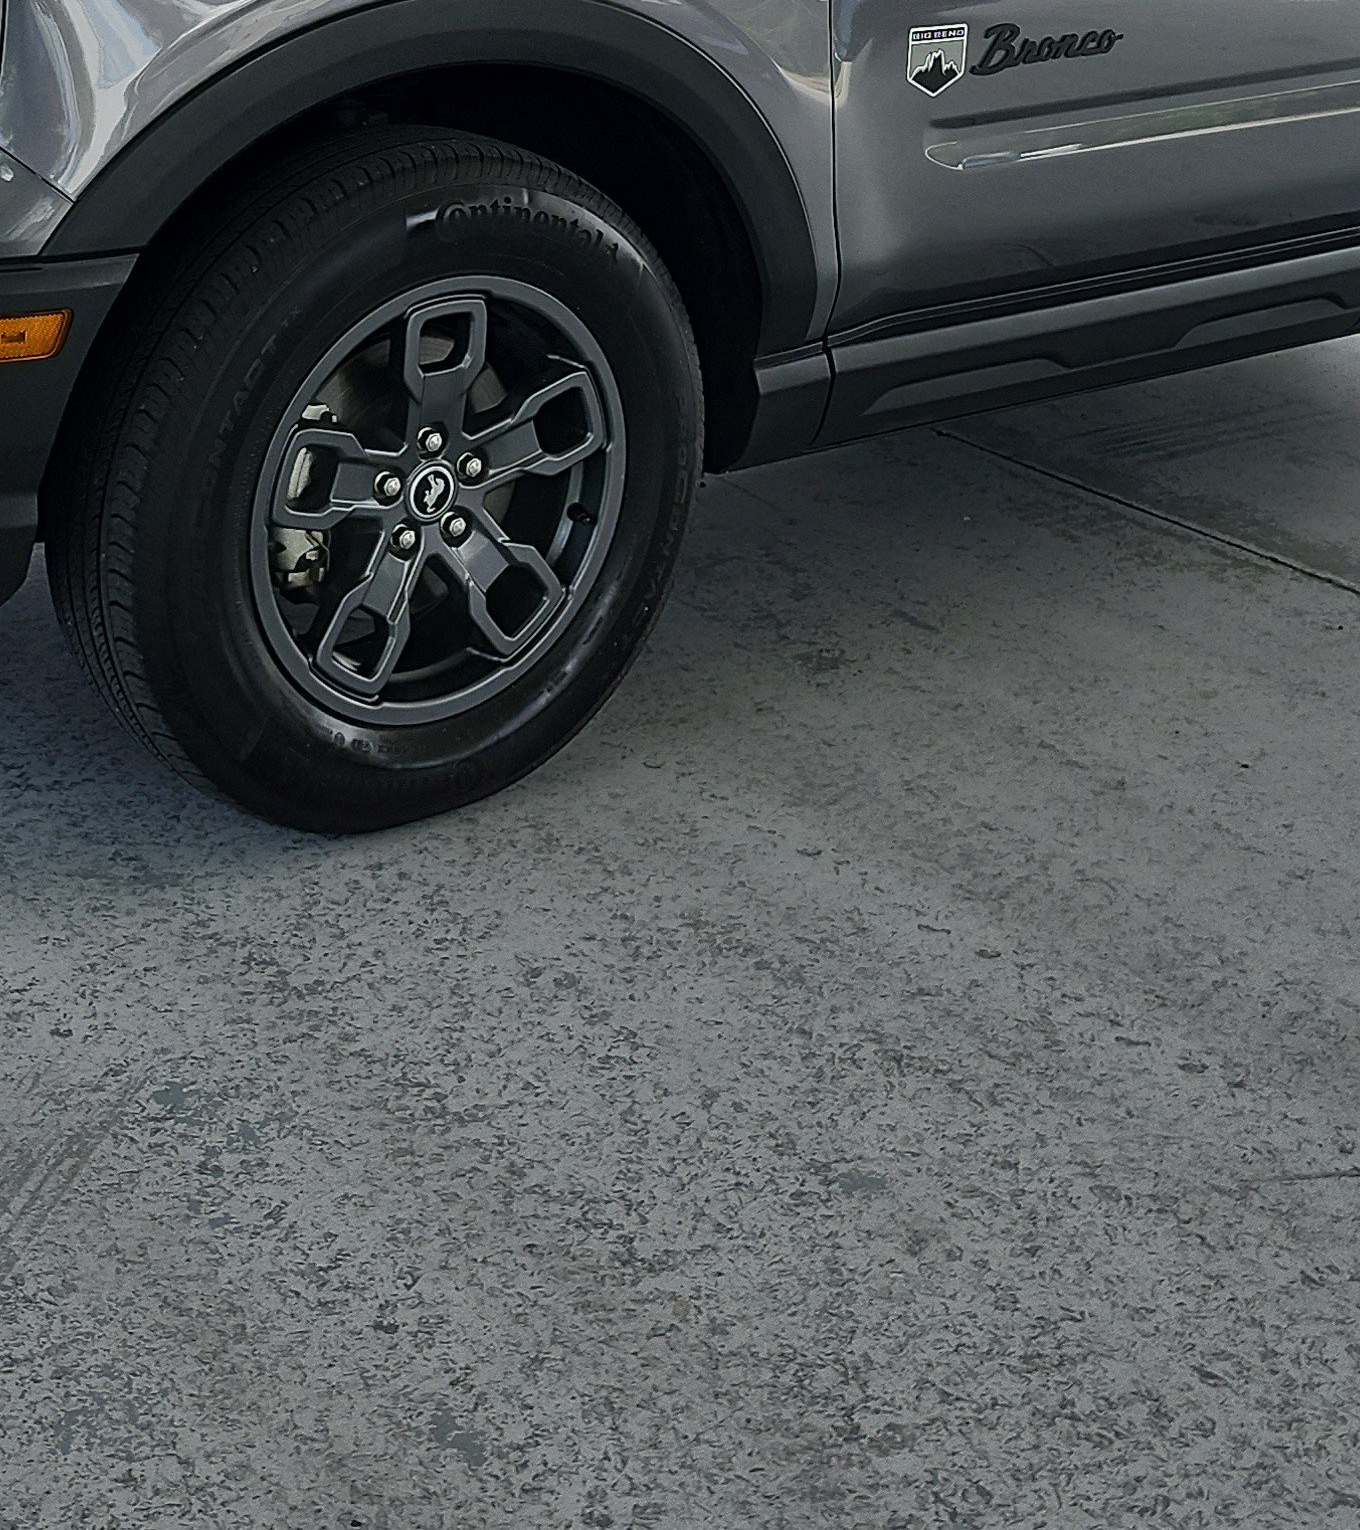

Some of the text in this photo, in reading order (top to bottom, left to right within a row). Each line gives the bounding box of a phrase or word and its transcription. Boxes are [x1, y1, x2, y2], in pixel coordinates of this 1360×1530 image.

[912, 28, 965, 41] BIG BEND
[969, 22, 1124, 76] Bronco
[434, 194, 605, 253] Continental
